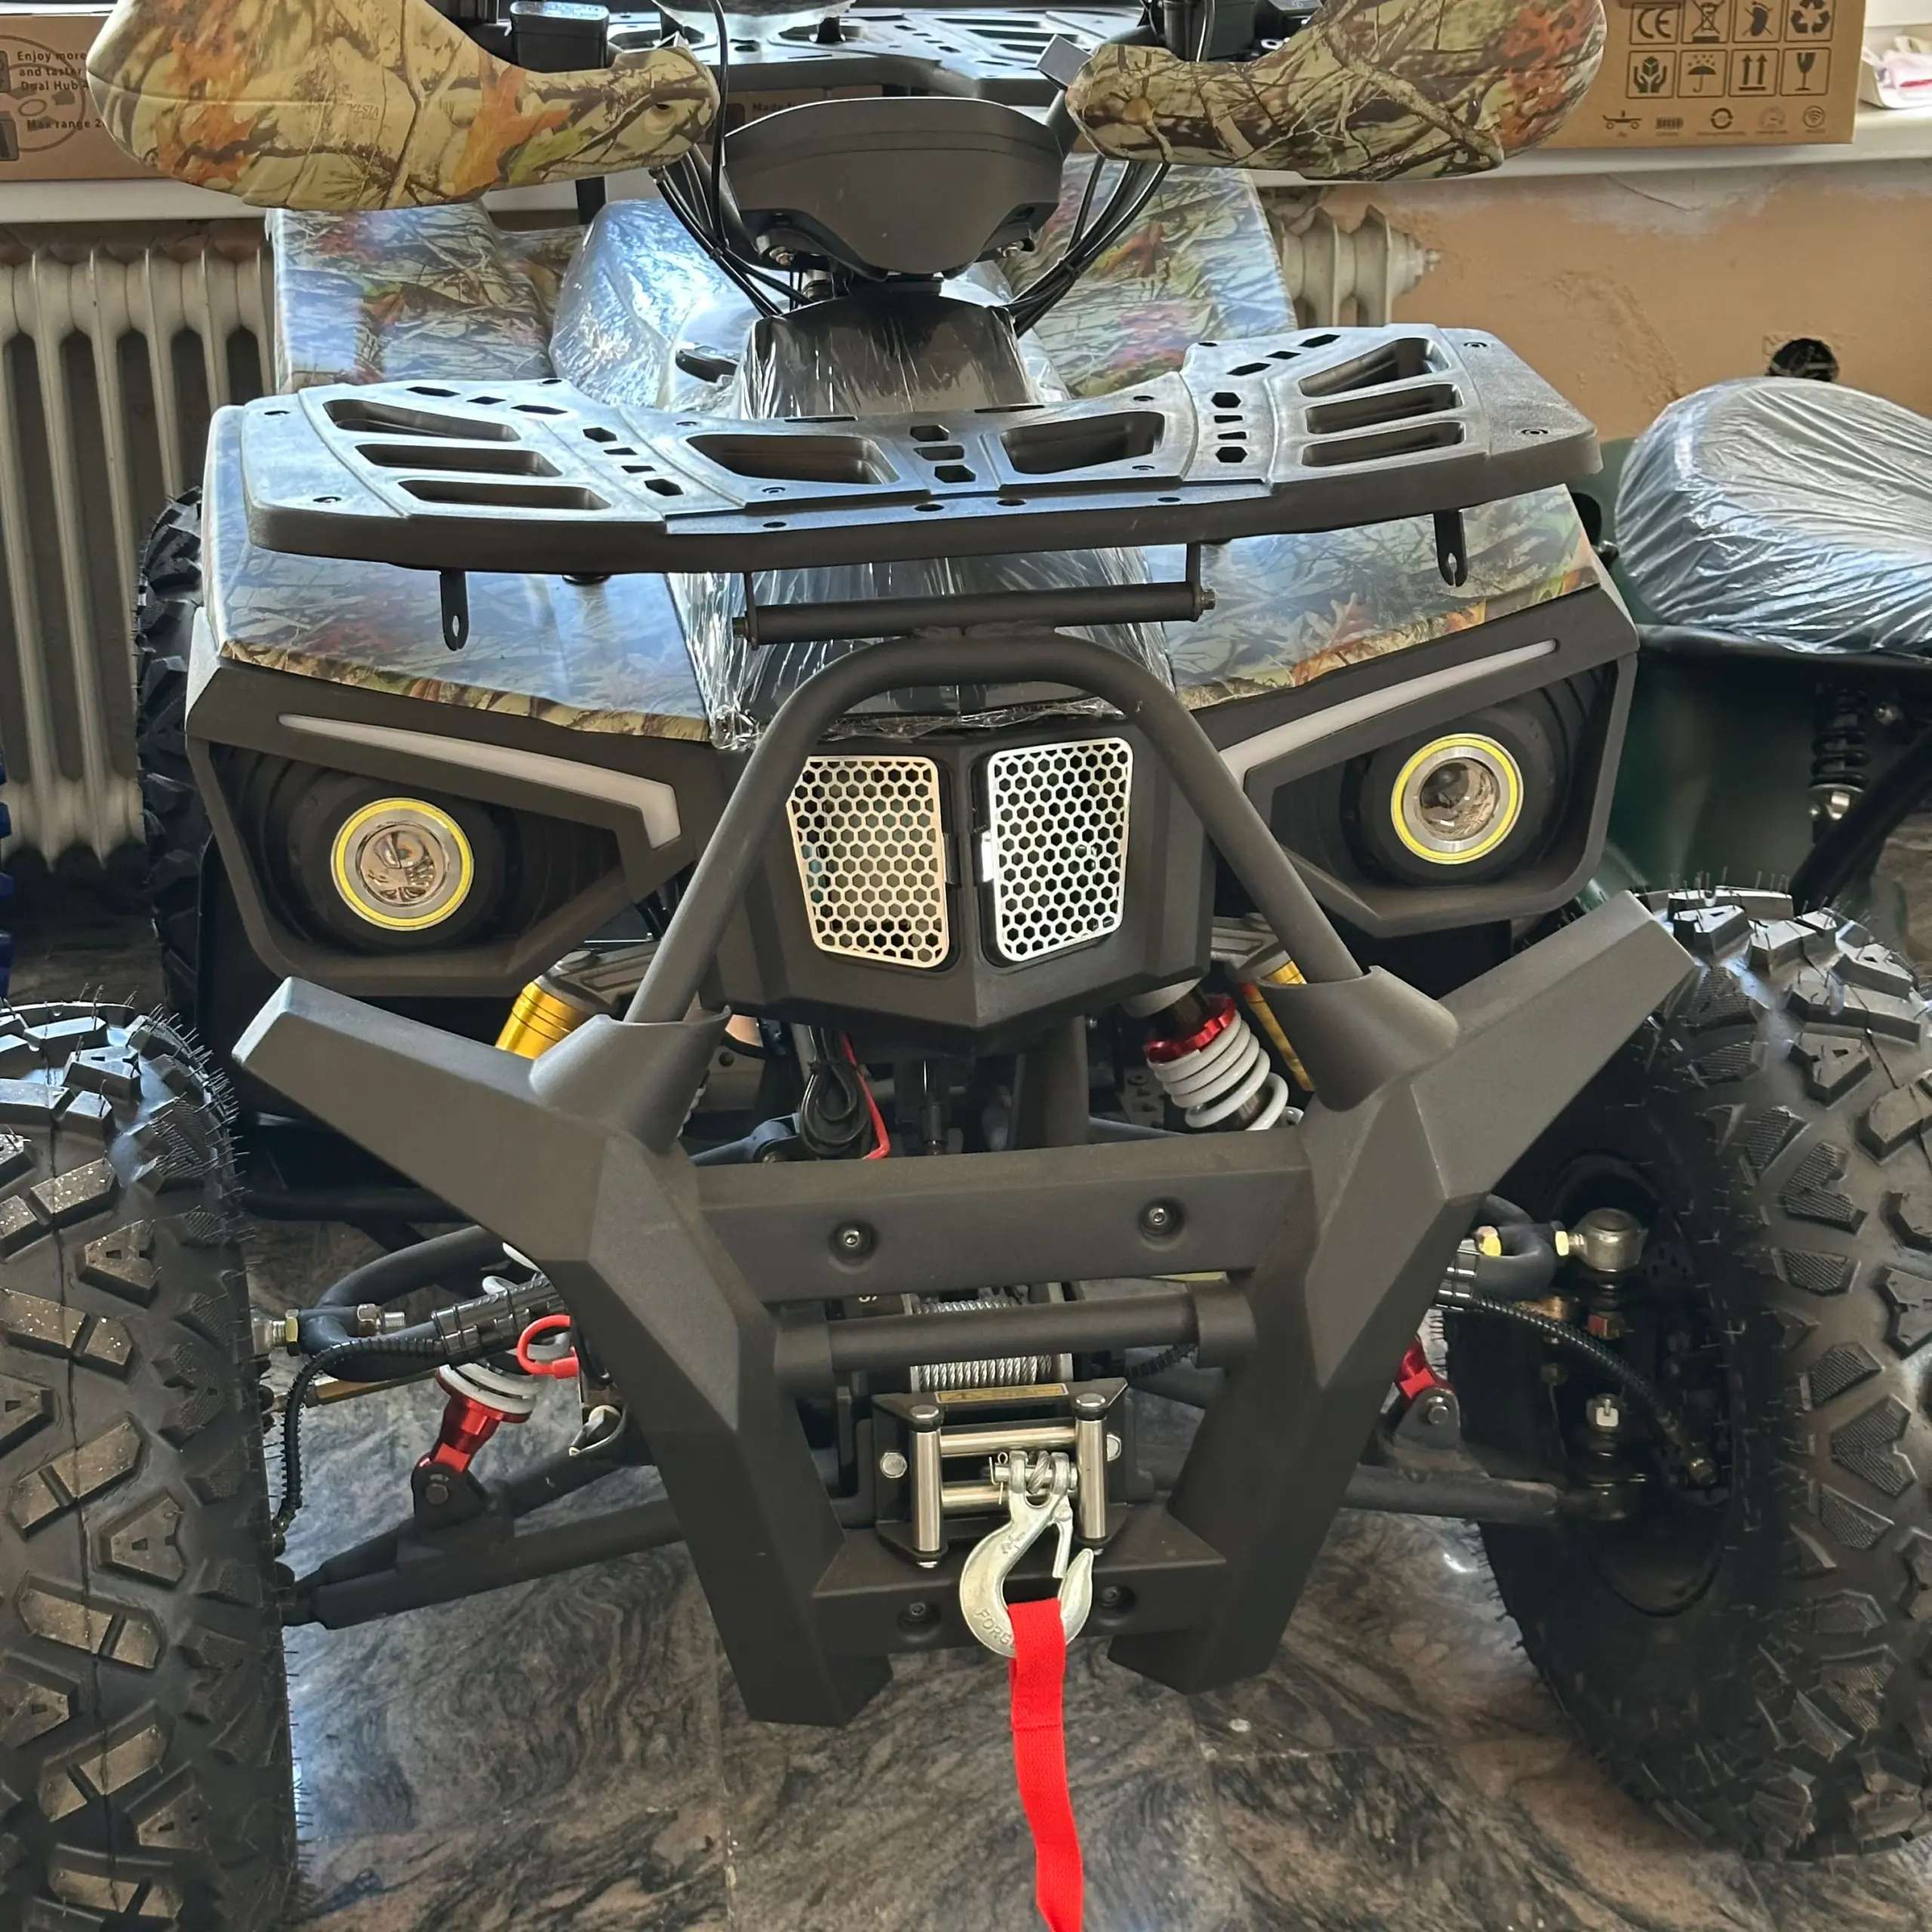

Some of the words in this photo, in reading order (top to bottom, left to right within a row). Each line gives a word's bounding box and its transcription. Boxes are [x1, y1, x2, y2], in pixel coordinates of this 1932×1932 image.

[17, 51, 51, 63] Enjoy
[56, 52, 87, 60] more
[19, 66, 42, 77] and
[21, 81, 49, 91] Dual
[54, 81, 78, 91] Hub
[55, 121, 90, 131] range
[974, 1607, 1014, 1648] FORG
